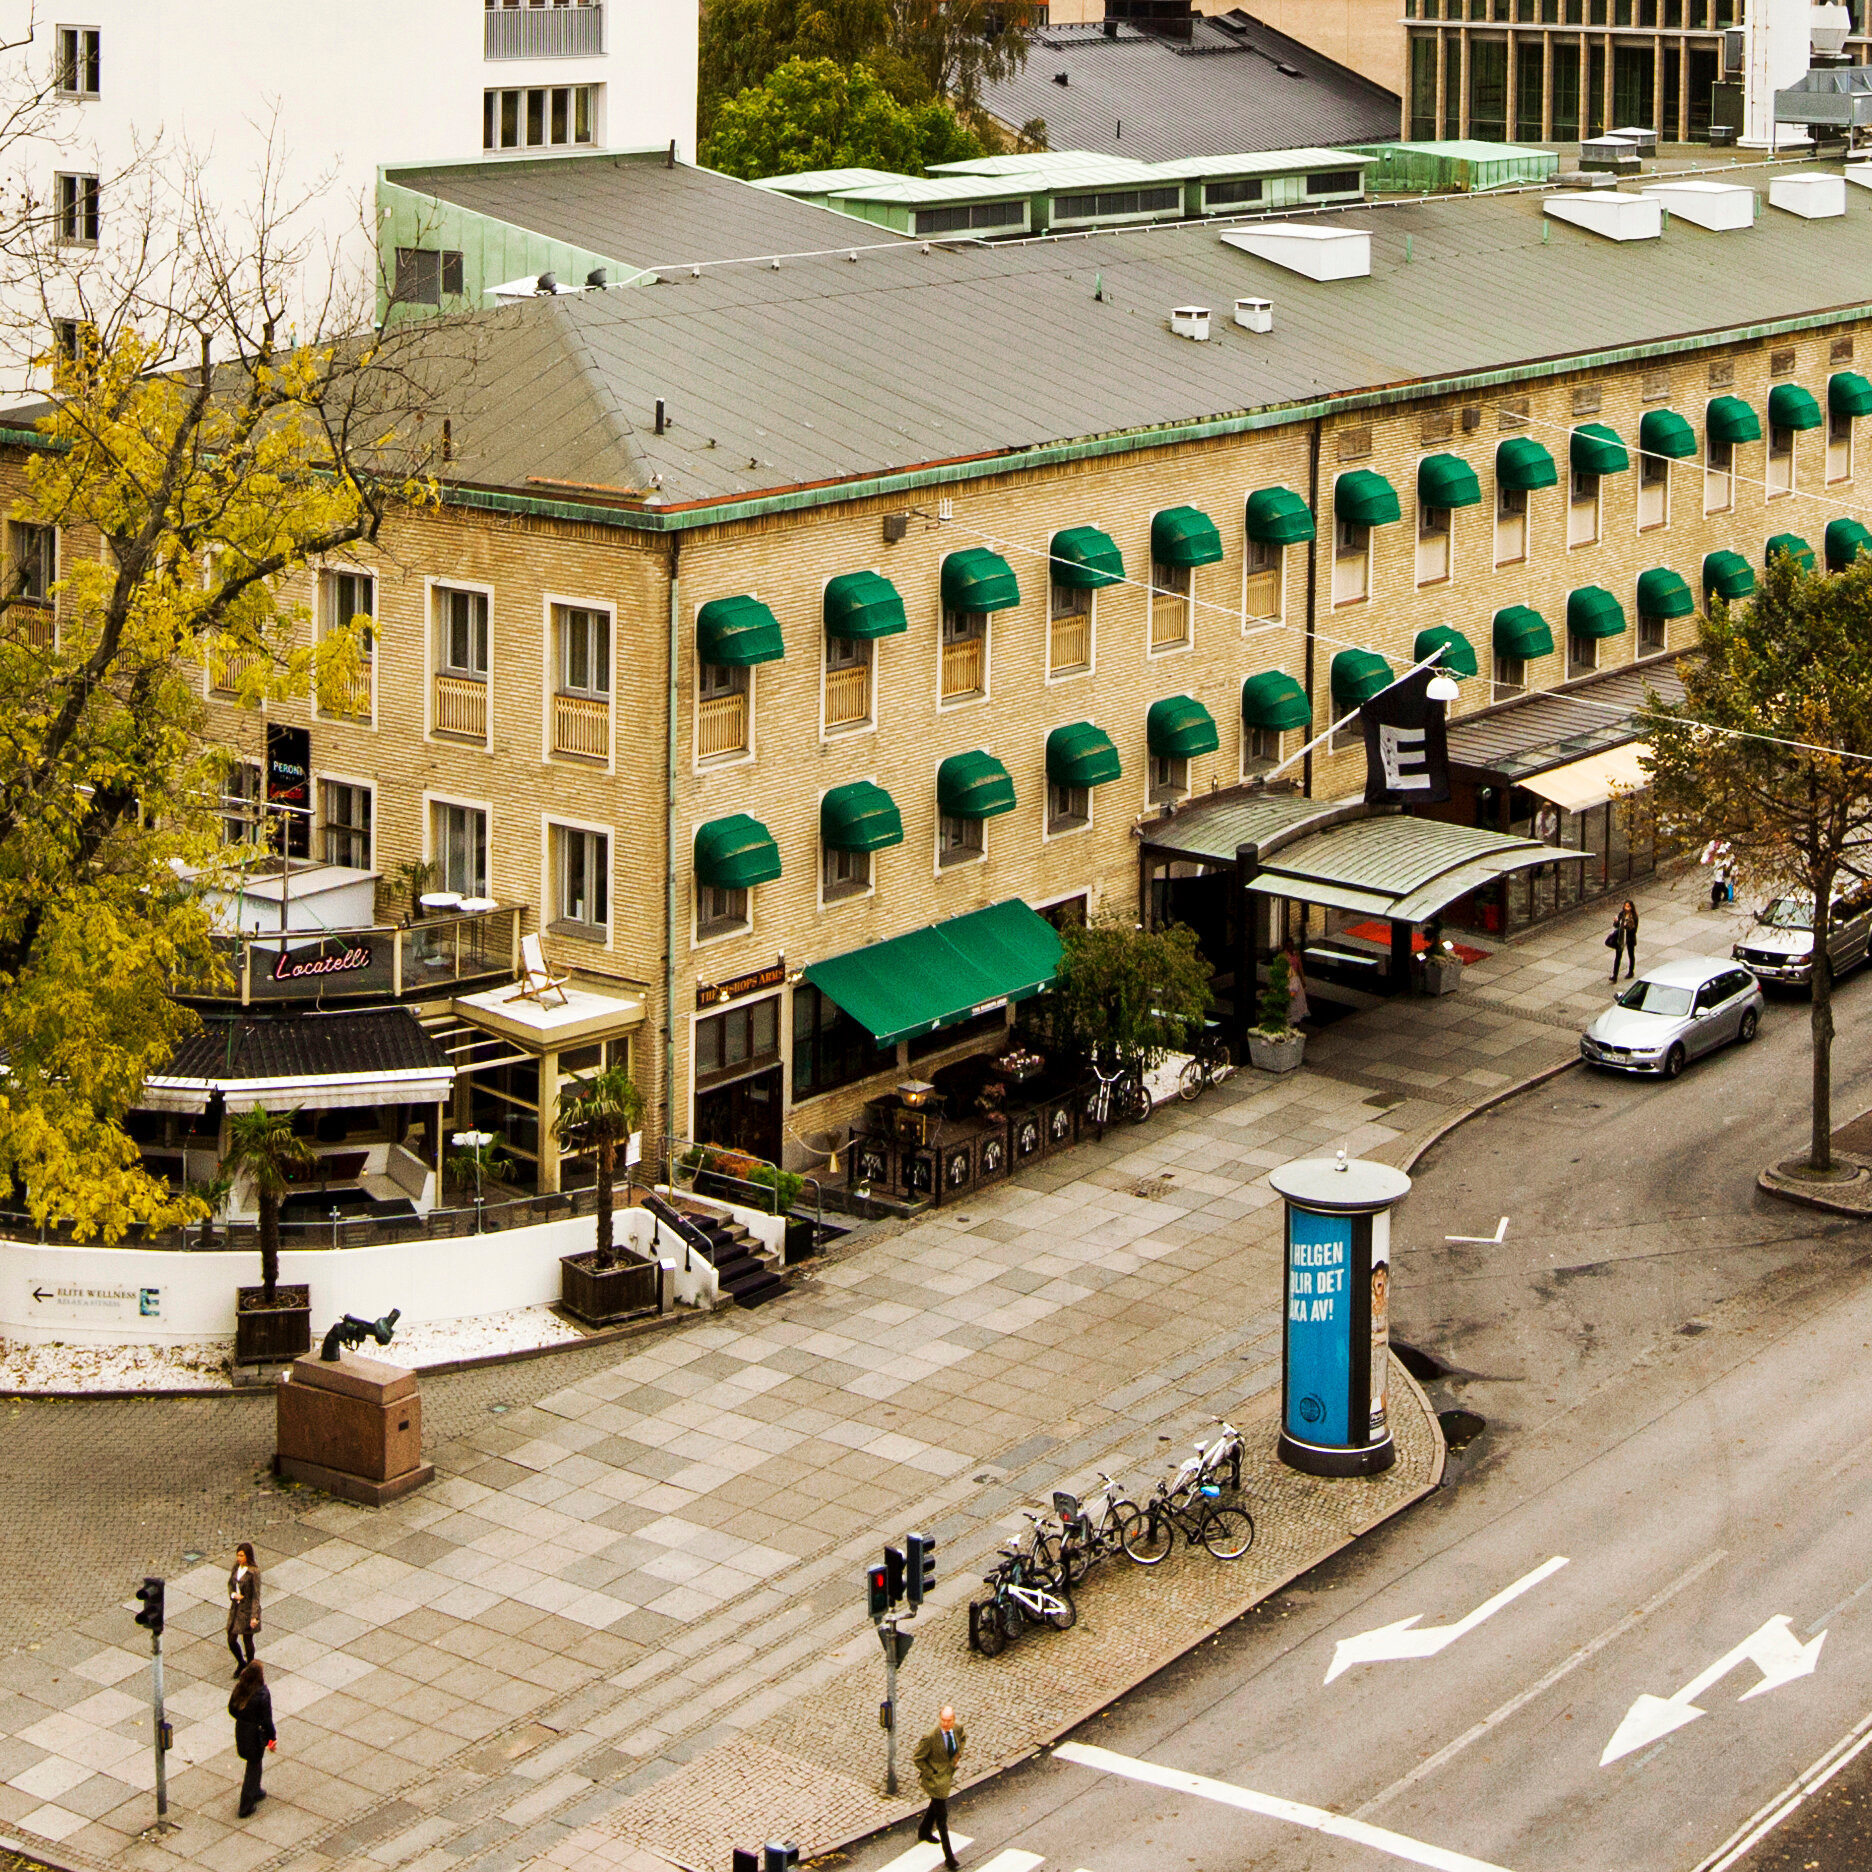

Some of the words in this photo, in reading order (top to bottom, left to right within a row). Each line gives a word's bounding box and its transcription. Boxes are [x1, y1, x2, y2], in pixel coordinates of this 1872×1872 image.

[1379, 724, 1431, 789] E
[276, 948, 370, 978] Locatelli
[1294, 1241, 1343, 1266] HELGEN
[1316, 1268, 1345, 1294] DET
[57, 1288, 83, 1297] ELITE
[87, 1289, 137, 1300] WELLNESS
[139, 1288, 160, 1316] E
[1310, 1298, 1334, 1322] AV!
